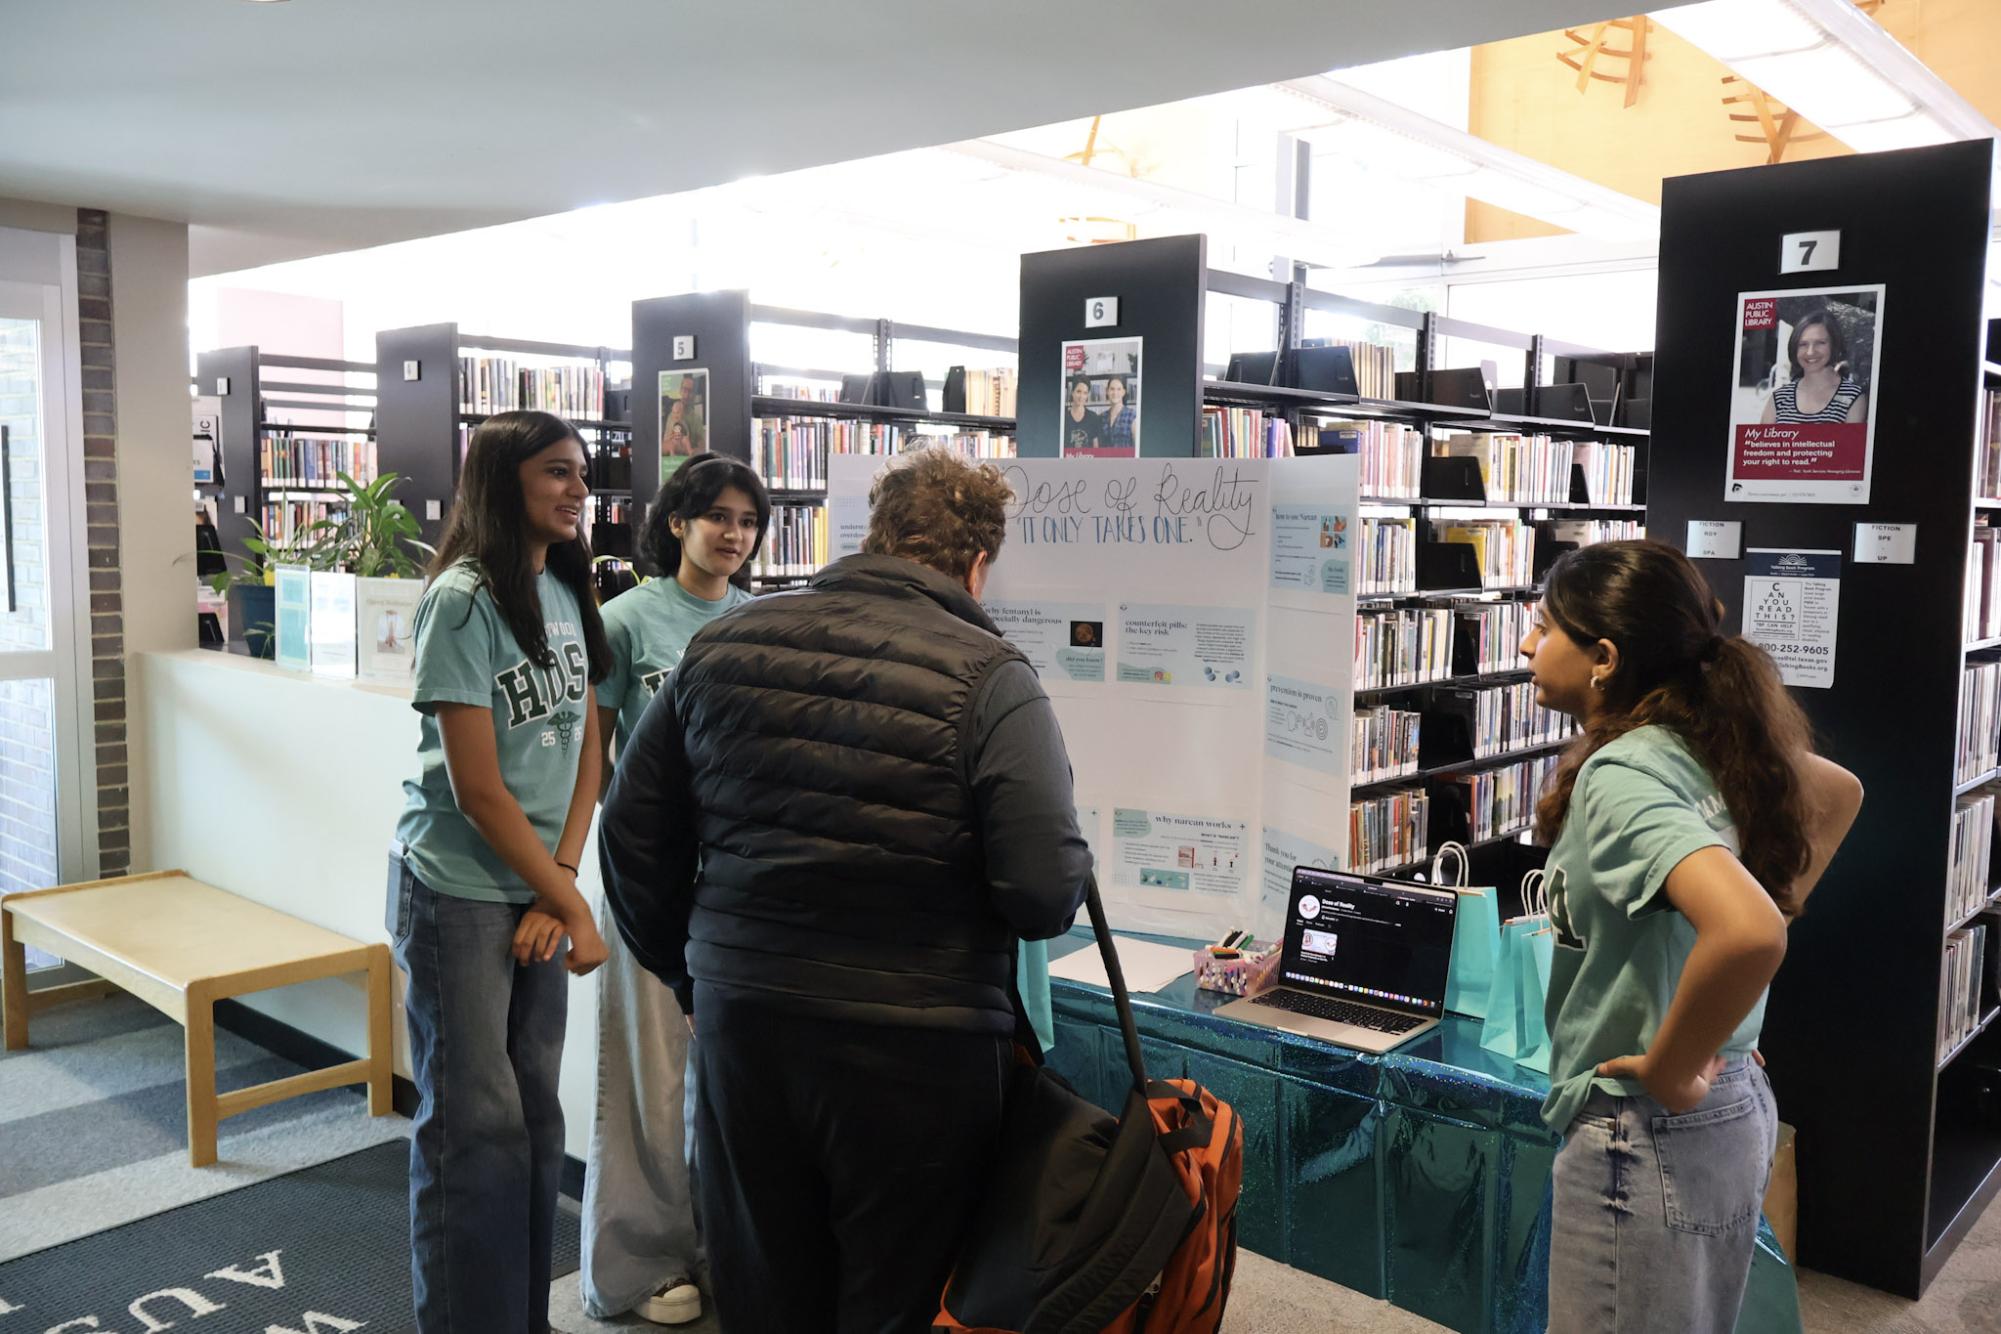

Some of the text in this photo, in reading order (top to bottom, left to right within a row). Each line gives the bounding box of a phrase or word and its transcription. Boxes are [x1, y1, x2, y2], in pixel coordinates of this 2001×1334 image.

[1798, 240, 1818, 266] 7
[1093, 301, 1104, 320] 6
[1746, 301, 1774, 310] AUSTIN
[1745, 309, 1769, 318] PUBLIC
[1744, 318, 1773, 327] LIBRARY
[677, 341, 685, 356] 5
[1744, 427, 1800, 441] My Library
[1782, 440, 1790, 448] in
[1792, 439, 1835, 449] intellectual
[1743, 449, 1833, 458] freedom and protecting
[1742, 458, 1760, 467] your
[1761, 457, 1780, 466] right
[1782, 458, 1790, 466] to
[1104, 476, 1137, 540] of
[1153, 462, 1260, 551] Reality
[1043, 516, 1084, 545] ONLY
[1091, 516, 1147, 545] TAKES
[1871, 524, 1901, 532] FICTION
[1772, 582, 1780, 591] C
[992, 615, 1021, 625] pecially
[1125, 619, 1168, 628] counterfeit
[1139, 627, 1152, 637] key
[1154, 628, 1170, 636] risk
[541, 731, 556, 747] 25
[1155, 815, 1232, 829] why narcan works
